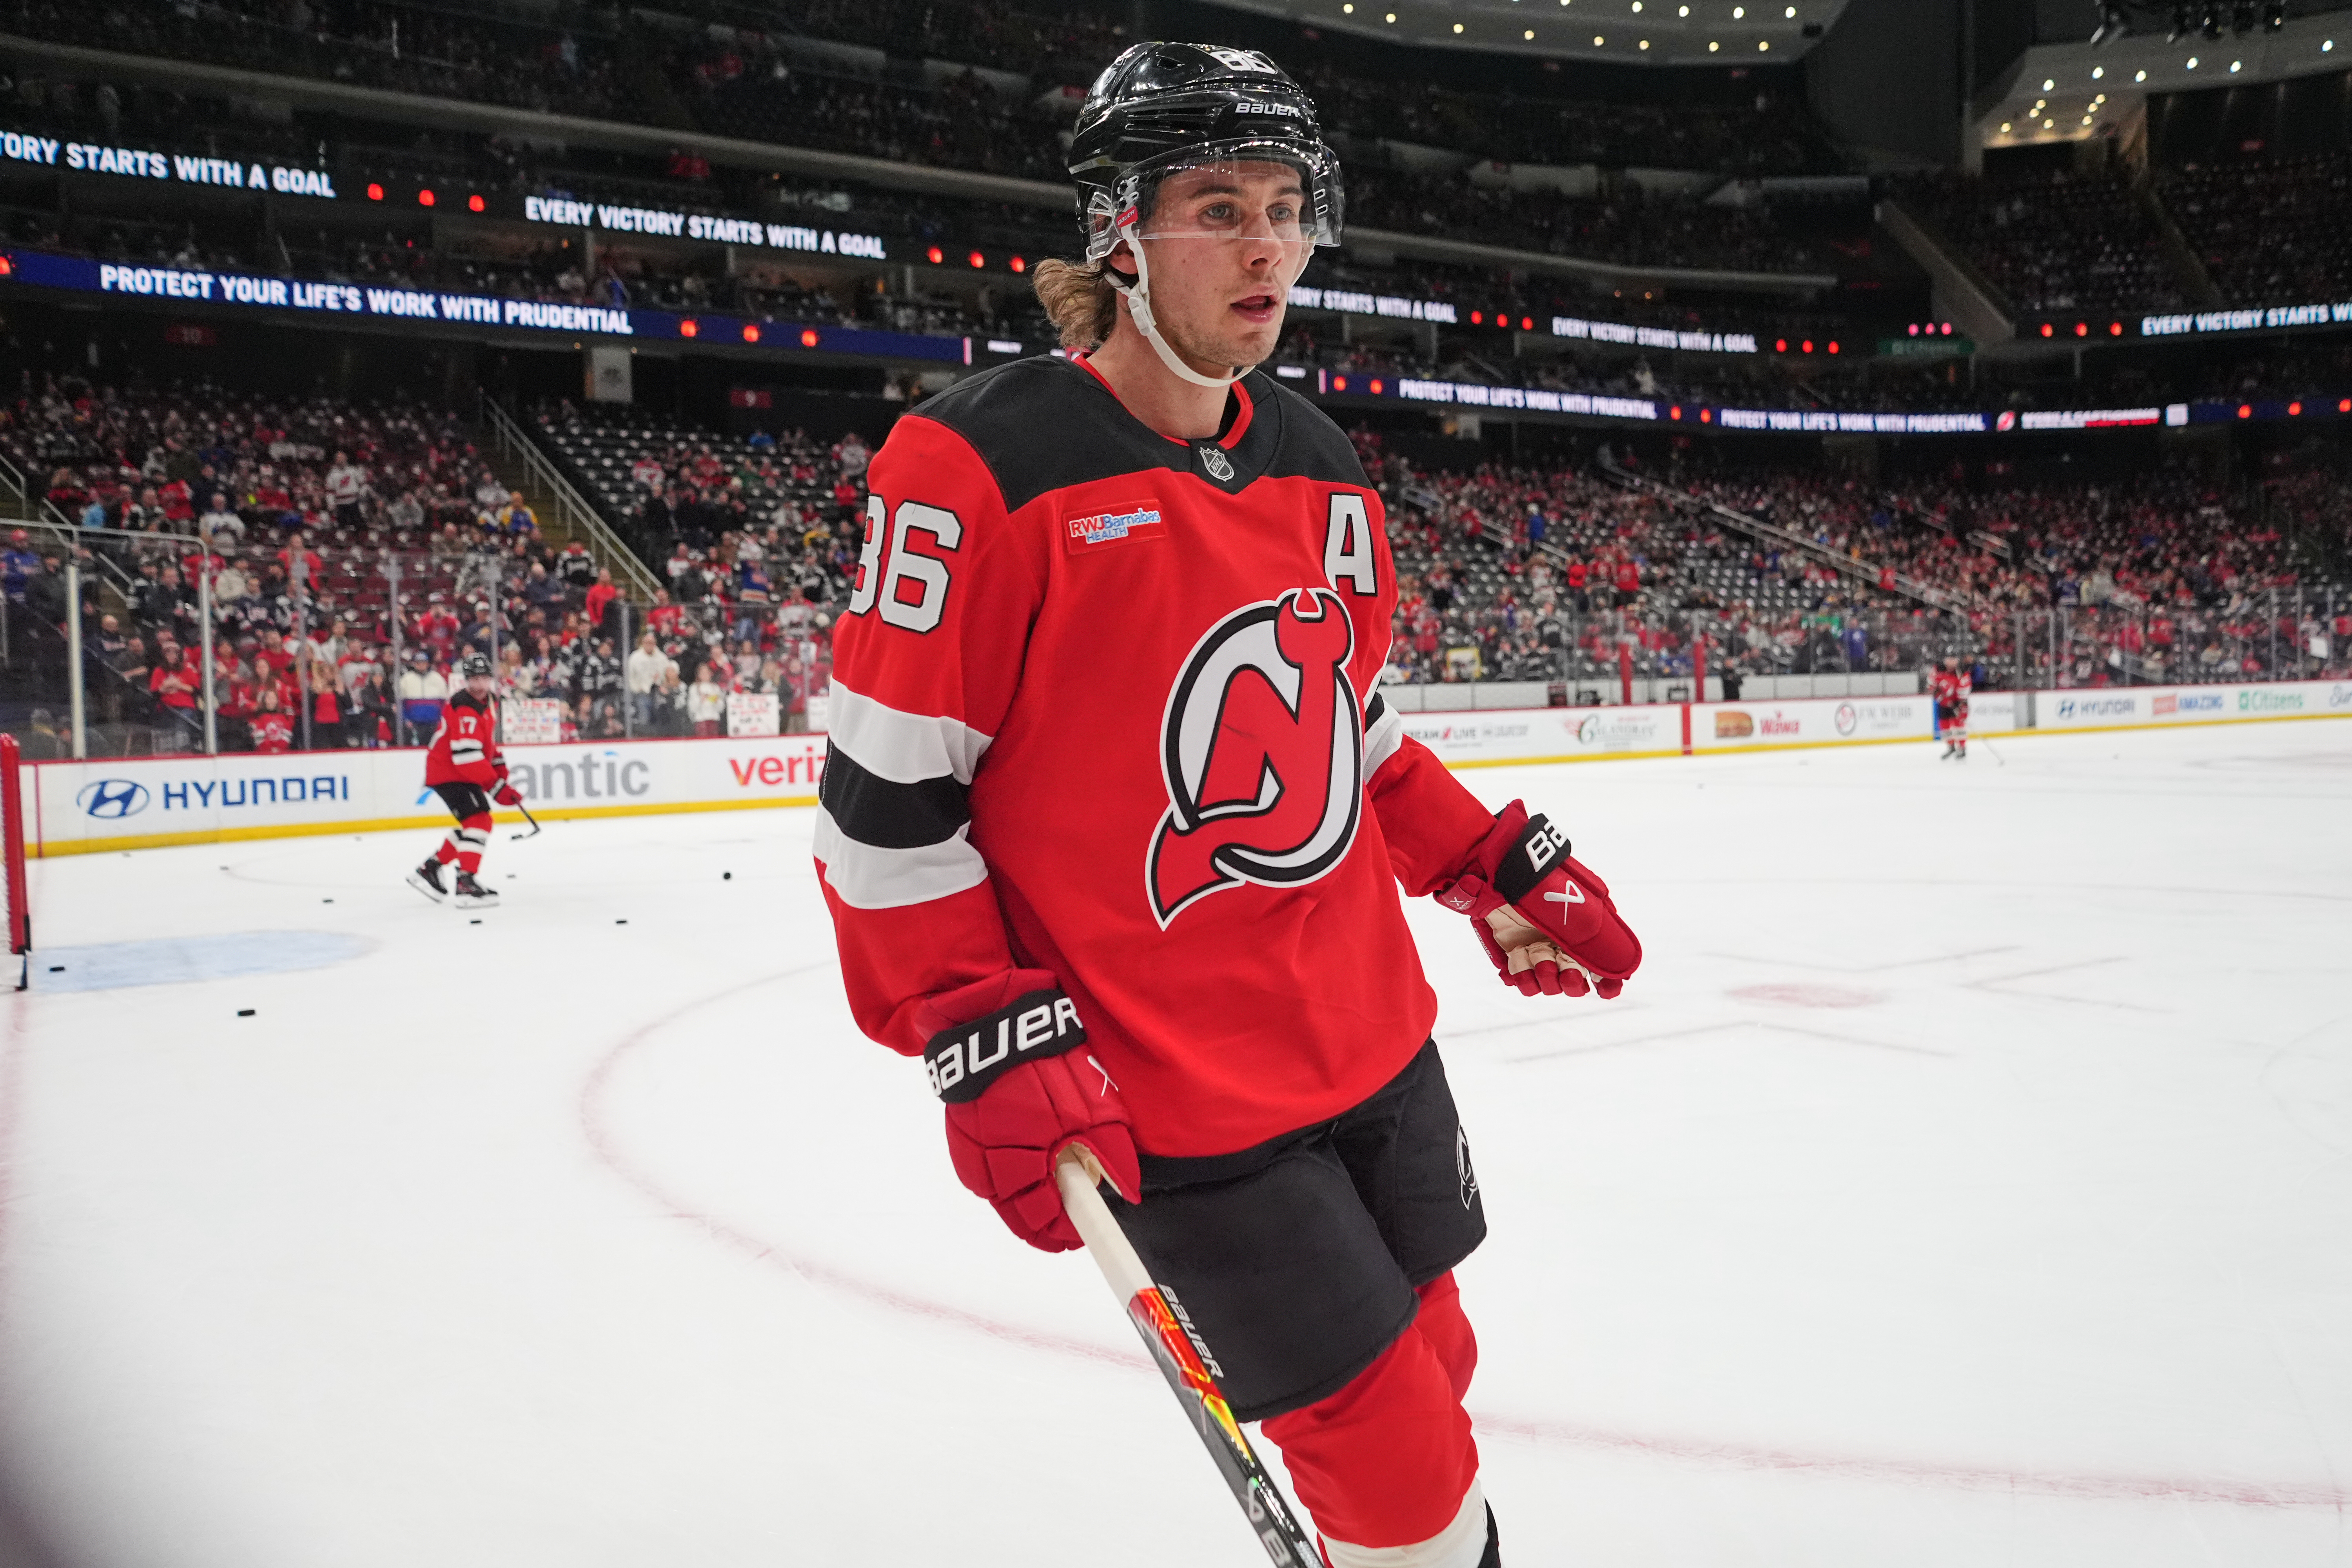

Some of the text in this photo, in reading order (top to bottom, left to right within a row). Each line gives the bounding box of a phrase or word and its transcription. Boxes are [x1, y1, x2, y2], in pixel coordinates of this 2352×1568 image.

[1210, 51, 1276, 74] 86
[67, 143, 166, 177] STARTS
[174, 155, 241, 186] WITH
[249, 164, 267, 189] A
[272, 167, 335, 197] GOAL
[525, 196, 886, 259] EVERY VICTORY STARTS WITH A GOAL
[1118, 209, 1135, 225] BAUER
[101, 265, 633, 334] PROTECT YOUR LIFE'S WORK WITH PRUDENTIAL
[1323, 290, 1375, 314] STARTS
[1376, 296, 1411, 318] WITH
[1412, 301, 1423, 319] A
[1424, 302, 1457, 323] GOAL
[1553, 317, 1757, 352] EVERY VICTORY STARTS WITH A GOAL
[2143, 314, 2192, 335] EVERY
[2196, 309, 2263, 331] VICTORY
[2267, 305, 2328, 326] STARTS
[1399, 379, 1657, 419] PROTECT YOUR LIFE'S WORK WITH PRUDENTIAL
[1721, 409, 1985, 432] PROTECT YOUR LIFE'S WORK WITH PRUDENTIAL
[1211, 457, 1223, 473] NHL
[1087, 527, 1127, 543] HEALTH
[1323, 492, 1378, 596] A
[2081, 699, 2135, 715] HYUNDAI
[2253, 690, 2303, 710] Citizens
[459, 715, 477, 734] 17
[1760, 718, 1800, 735] Wawa
[510, 752, 650, 800] antic
[730, 746, 826, 786] veri
[163, 776, 349, 809] HYUNDAI
[925, 997, 1083, 1097] BAUER
[1158, 1283, 1224, 1378] BAUER
